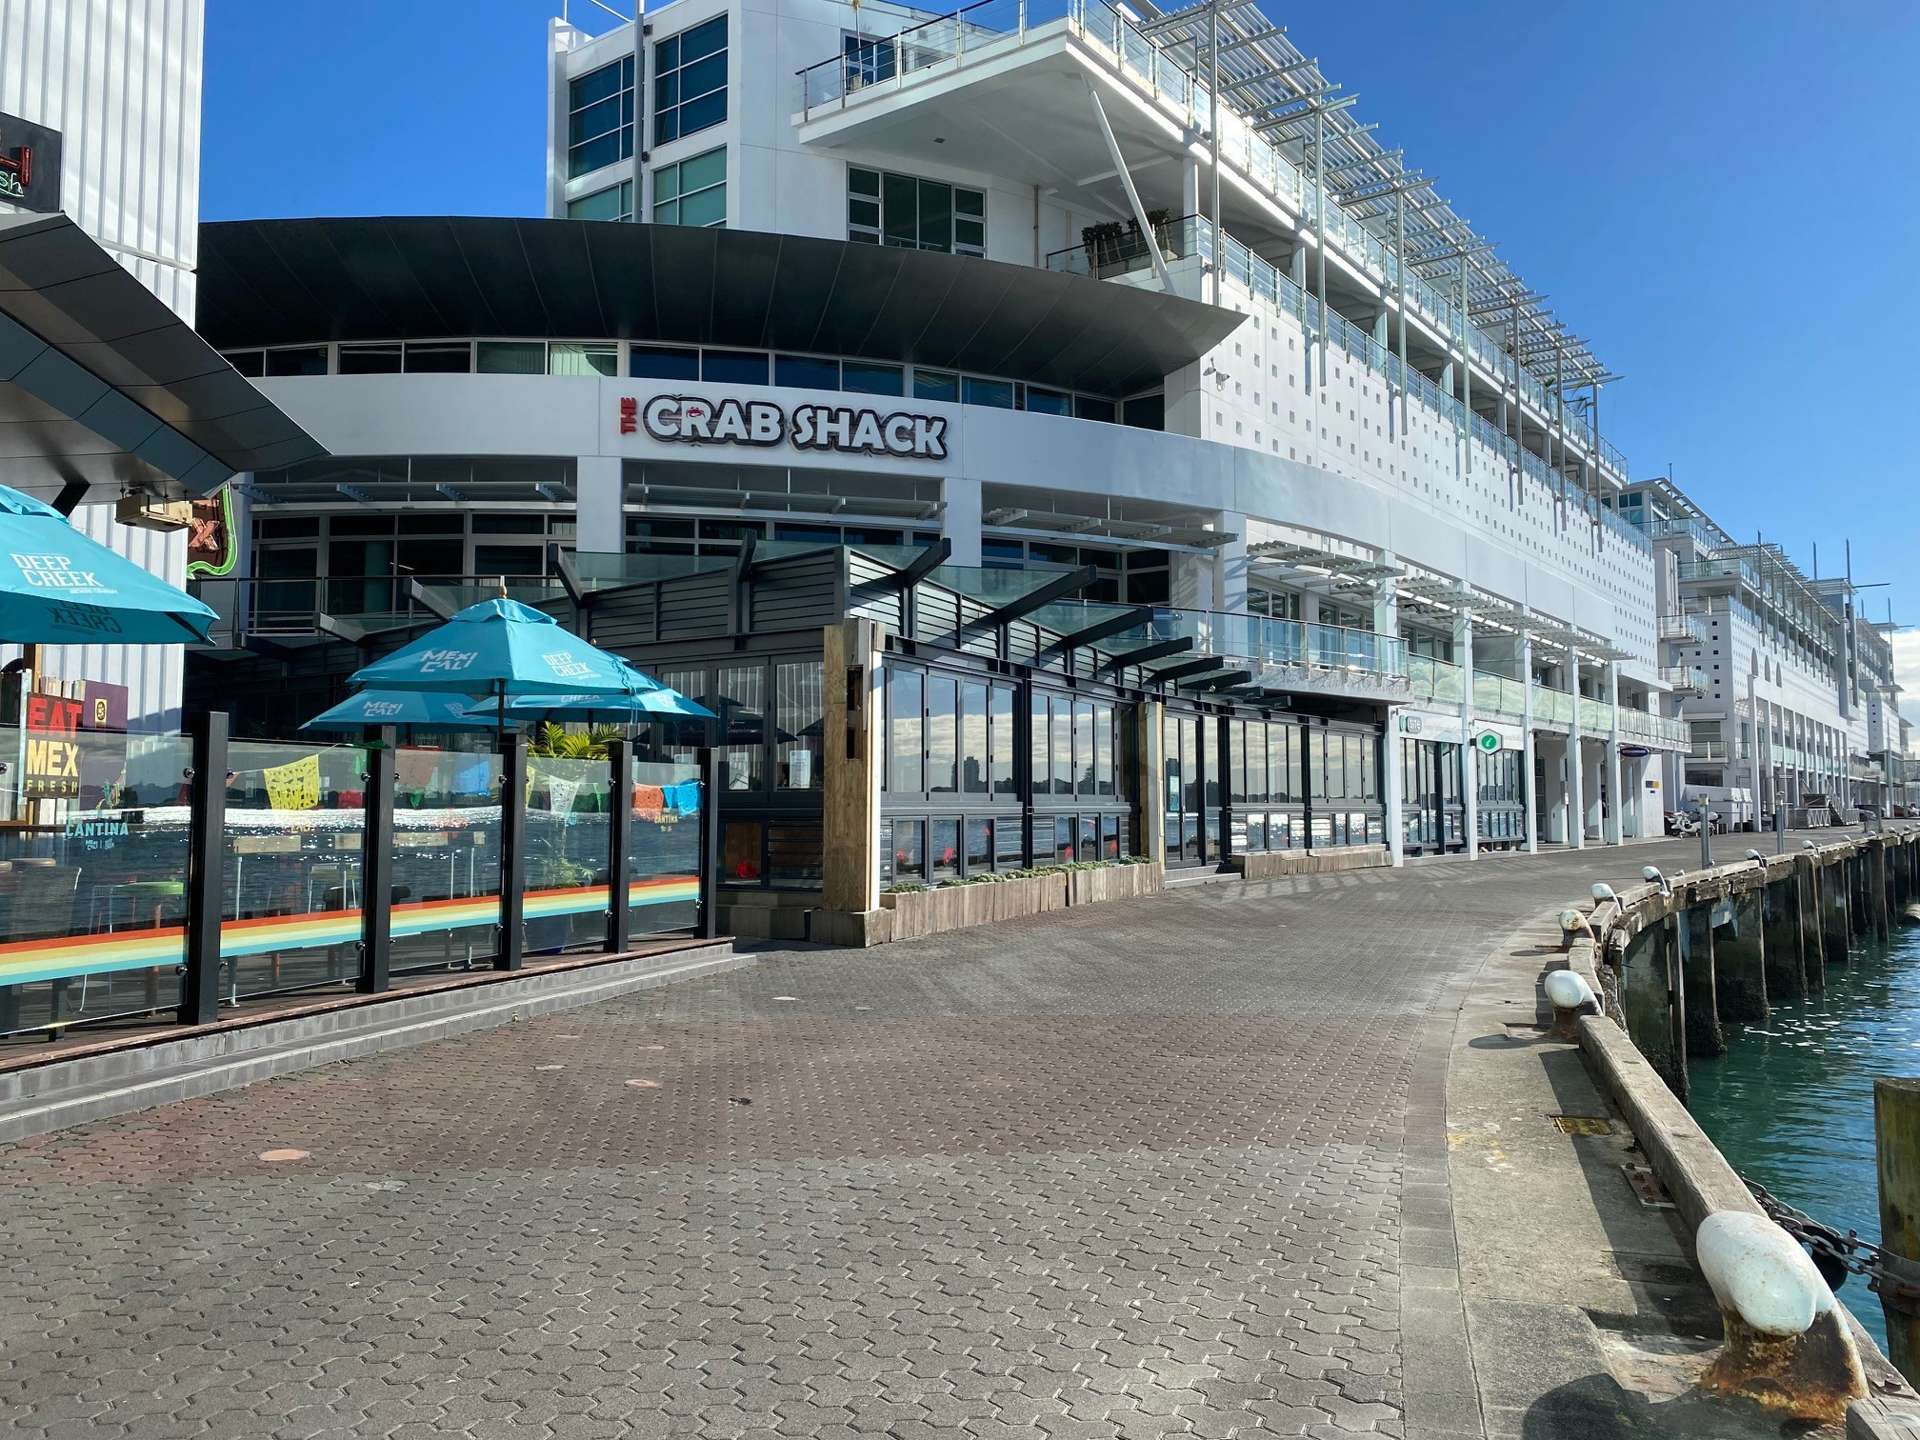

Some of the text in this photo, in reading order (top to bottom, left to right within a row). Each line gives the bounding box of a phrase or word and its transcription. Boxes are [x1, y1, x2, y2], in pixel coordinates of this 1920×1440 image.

[620, 396, 947, 456] THE CRAB SHACK
[9, 553, 71, 570] DEEP
[22, 569, 104, 587] CREEK
[420, 649, 478, 662] MEXI
[28, 696, 82, 736] EAT
[26, 739, 79, 776] MEX
[26, 779, 79, 793] FRESH
[66, 822, 129, 837] CANTINA
